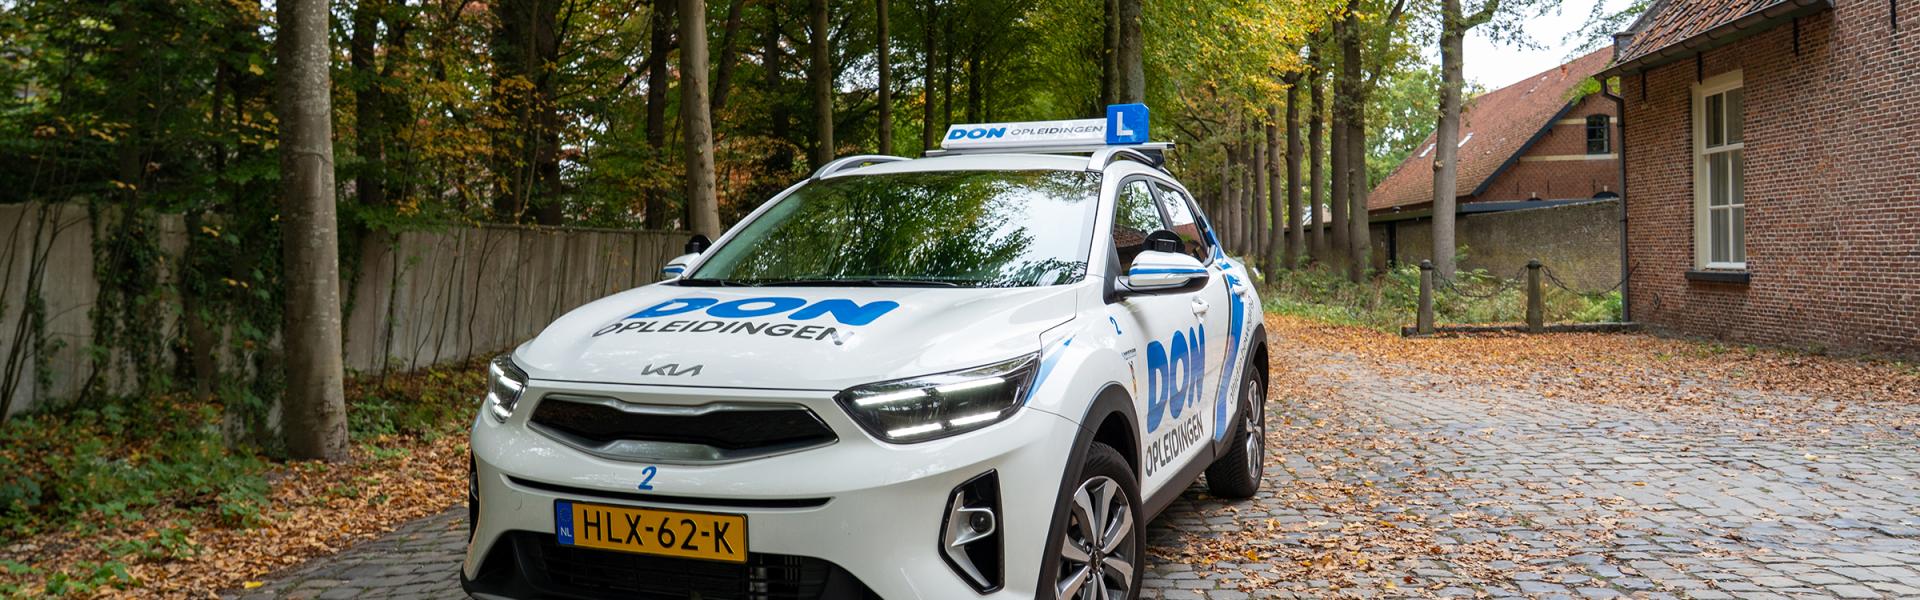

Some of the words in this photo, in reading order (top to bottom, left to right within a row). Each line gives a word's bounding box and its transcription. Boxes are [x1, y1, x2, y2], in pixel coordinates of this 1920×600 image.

[949, 127, 1006, 140] DON
[1010, 126, 1104, 136] OPLEIDINGEN
[1116, 111, 1134, 136] L
[622, 297, 900, 326] DON
[592, 320, 855, 346] OPLEIDINGEN
[1109, 316, 1122, 335] 2
[1146, 323, 1206, 434] DON
[1145, 411, 1204, 477] OPLEIDINGEN
[638, 465, 657, 490] 2
[560, 527, 572, 537] NL
[583, 509, 734, 555] HLX-62-K
